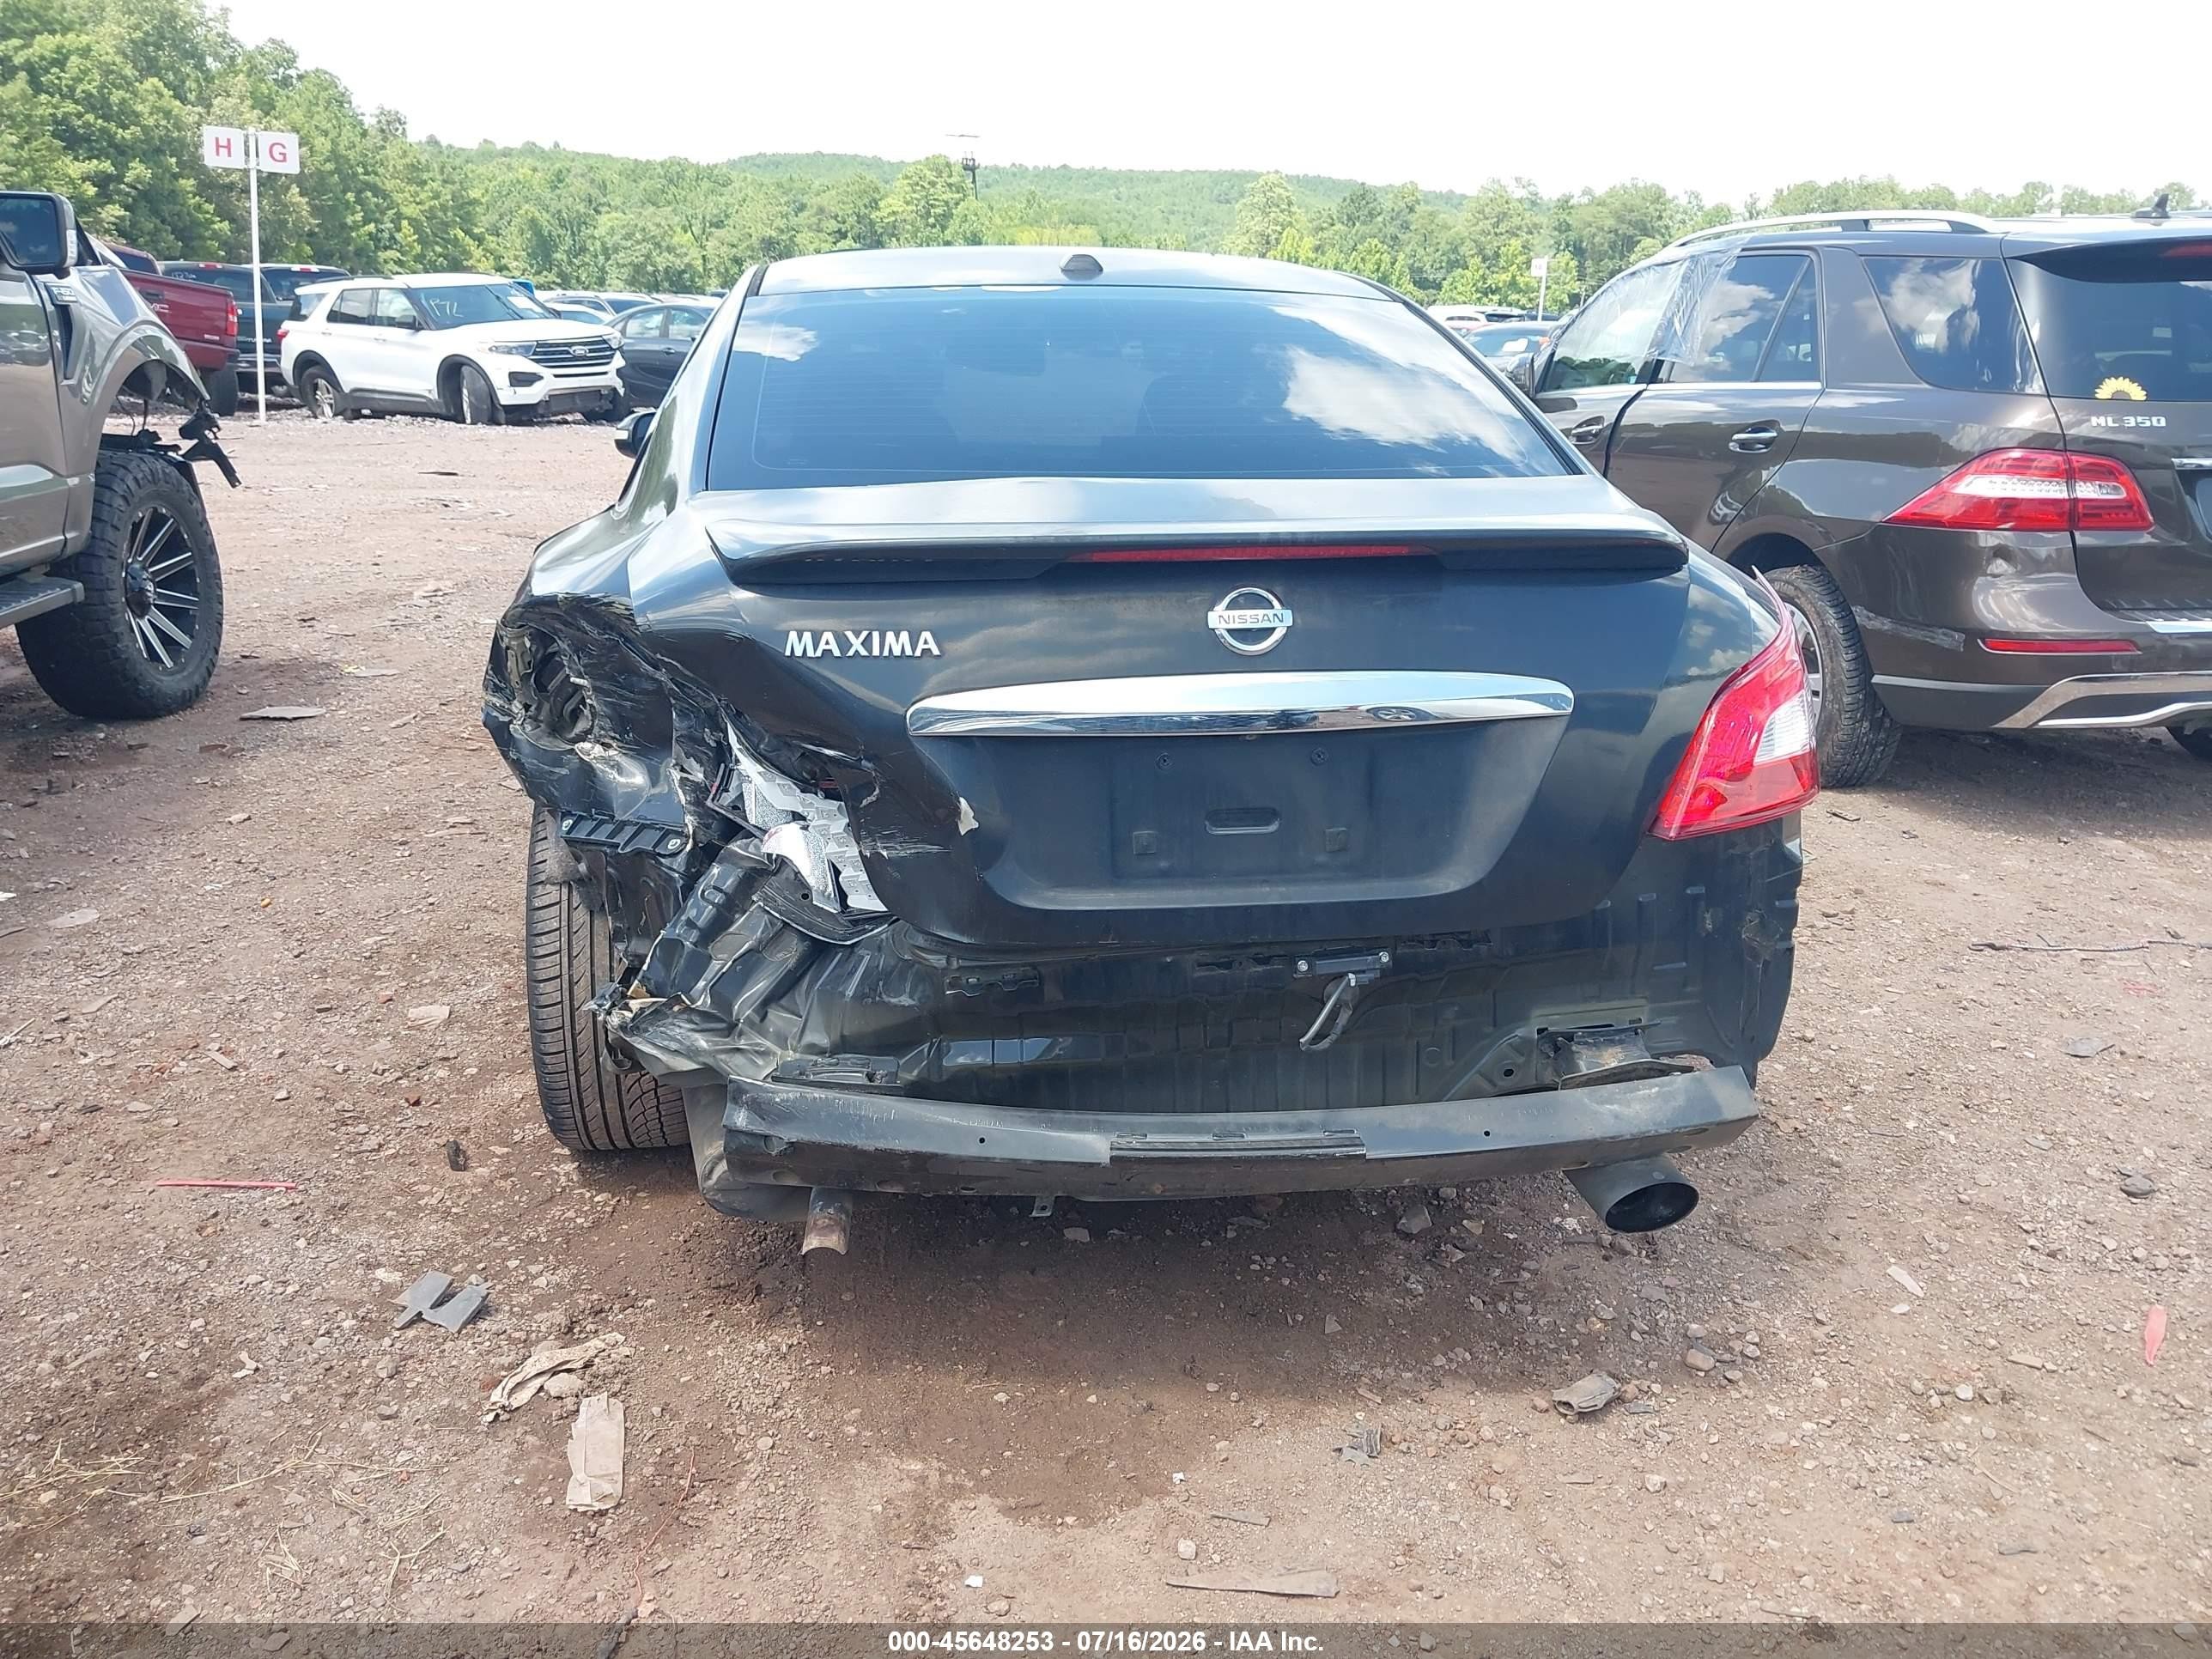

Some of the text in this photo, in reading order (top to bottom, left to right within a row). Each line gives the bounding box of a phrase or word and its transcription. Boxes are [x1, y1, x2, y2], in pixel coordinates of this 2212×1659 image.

[215, 137, 232, 158] H
[269, 142, 288, 163] G
[2091, 416, 2166, 427] ML 350
[1218, 613, 1285, 625] NISSAN
[785, 630, 942, 658] MAXIMA
